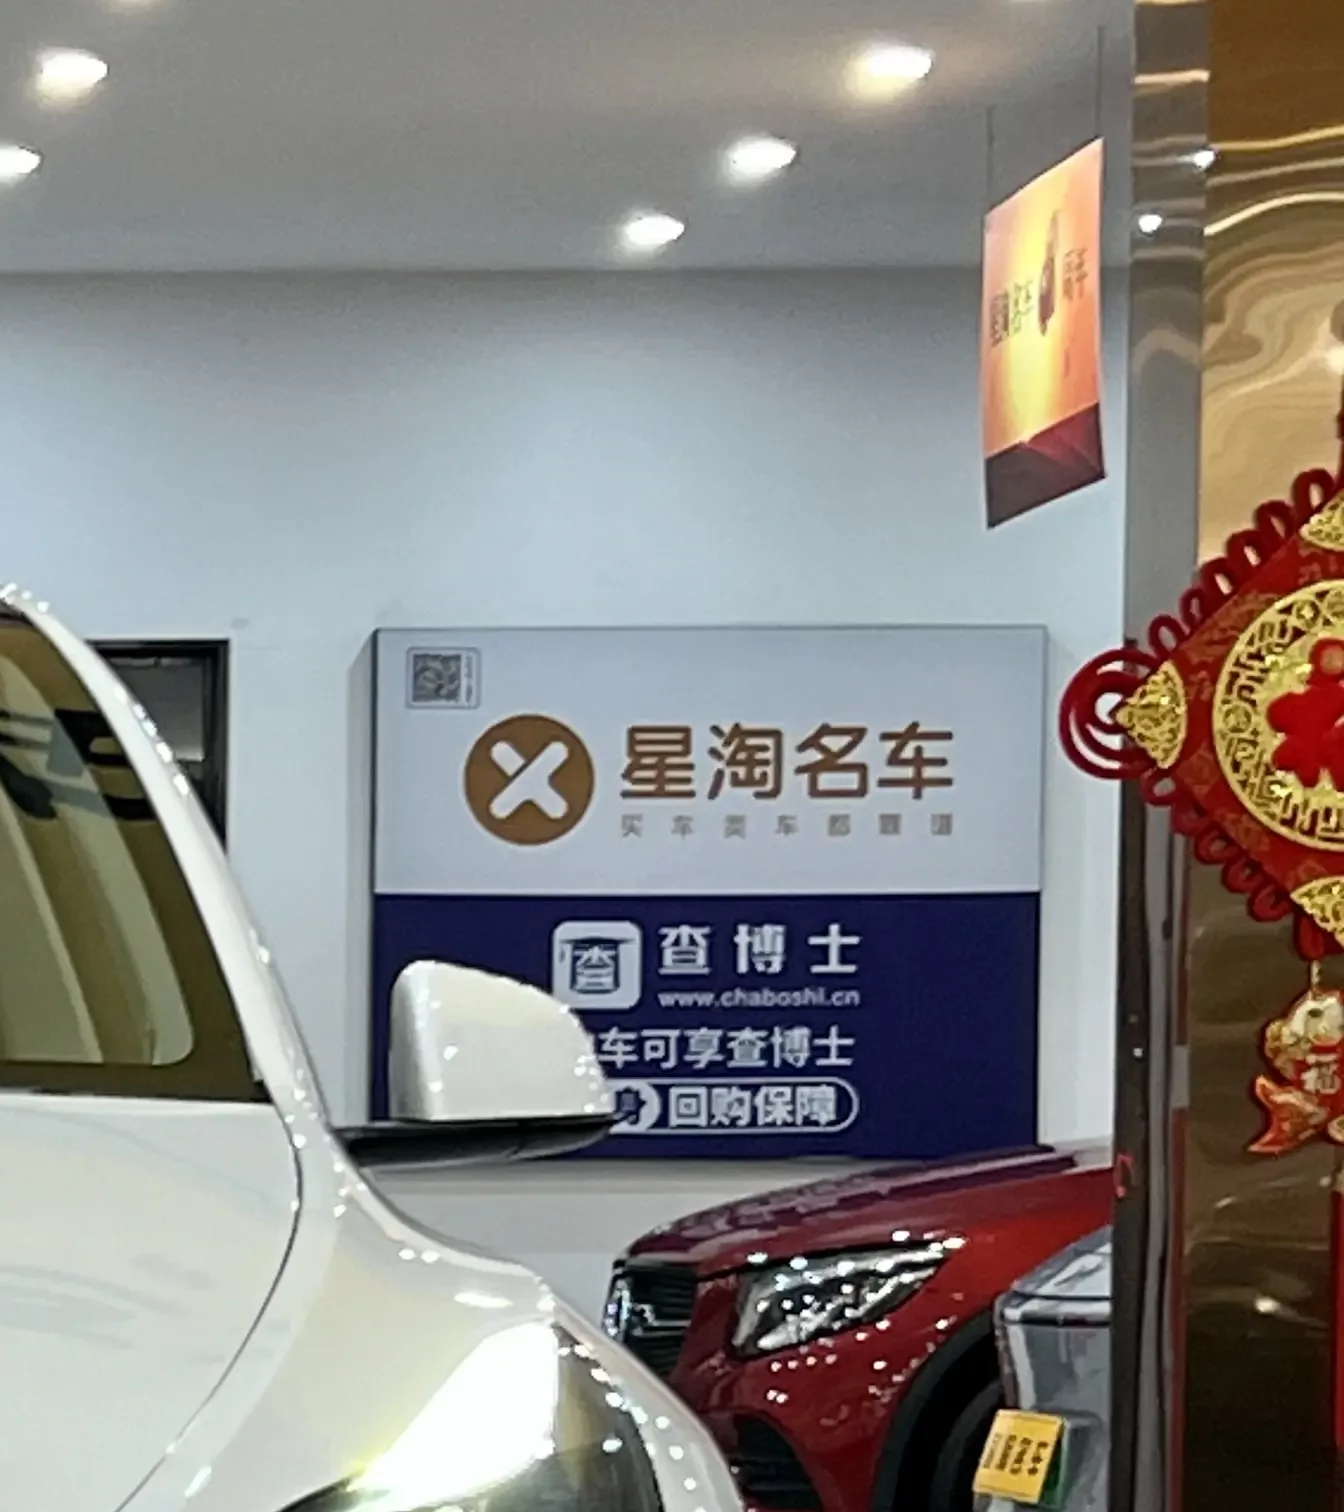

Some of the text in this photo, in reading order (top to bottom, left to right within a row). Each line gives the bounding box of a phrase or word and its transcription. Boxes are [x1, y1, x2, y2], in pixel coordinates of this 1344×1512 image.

[619, 721, 955, 801] 星淘名车
[657, 923, 861, 974] 查博士
[657, 986, 861, 1008] www.chaboshi.cn
[597, 1024, 856, 1069] 车可享查博士
[668, 1084, 838, 1127] 回购保障
